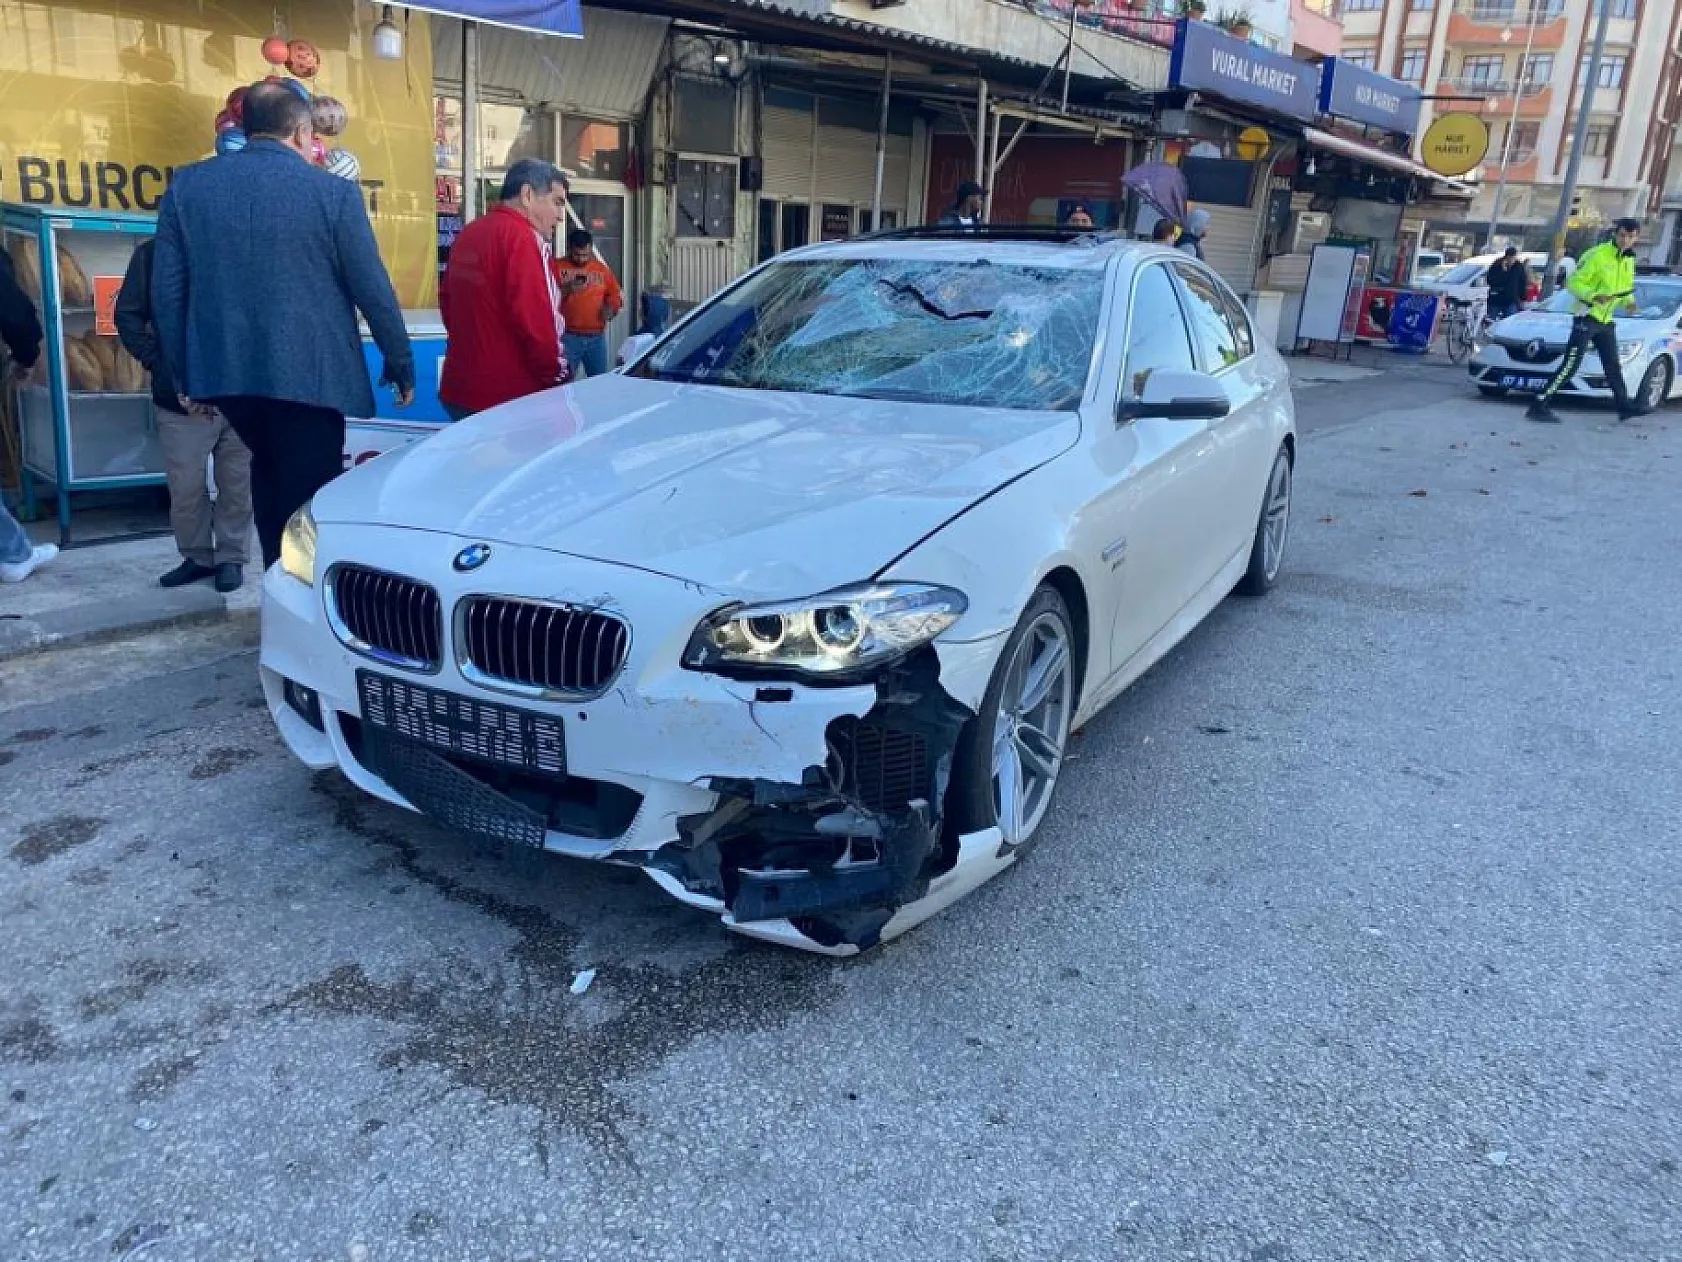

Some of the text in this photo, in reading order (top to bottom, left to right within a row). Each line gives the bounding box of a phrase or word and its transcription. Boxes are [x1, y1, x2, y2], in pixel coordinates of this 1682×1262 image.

[1212, 48, 1298, 96] VURAL MARKET
[18, 156, 174, 212] BURC
